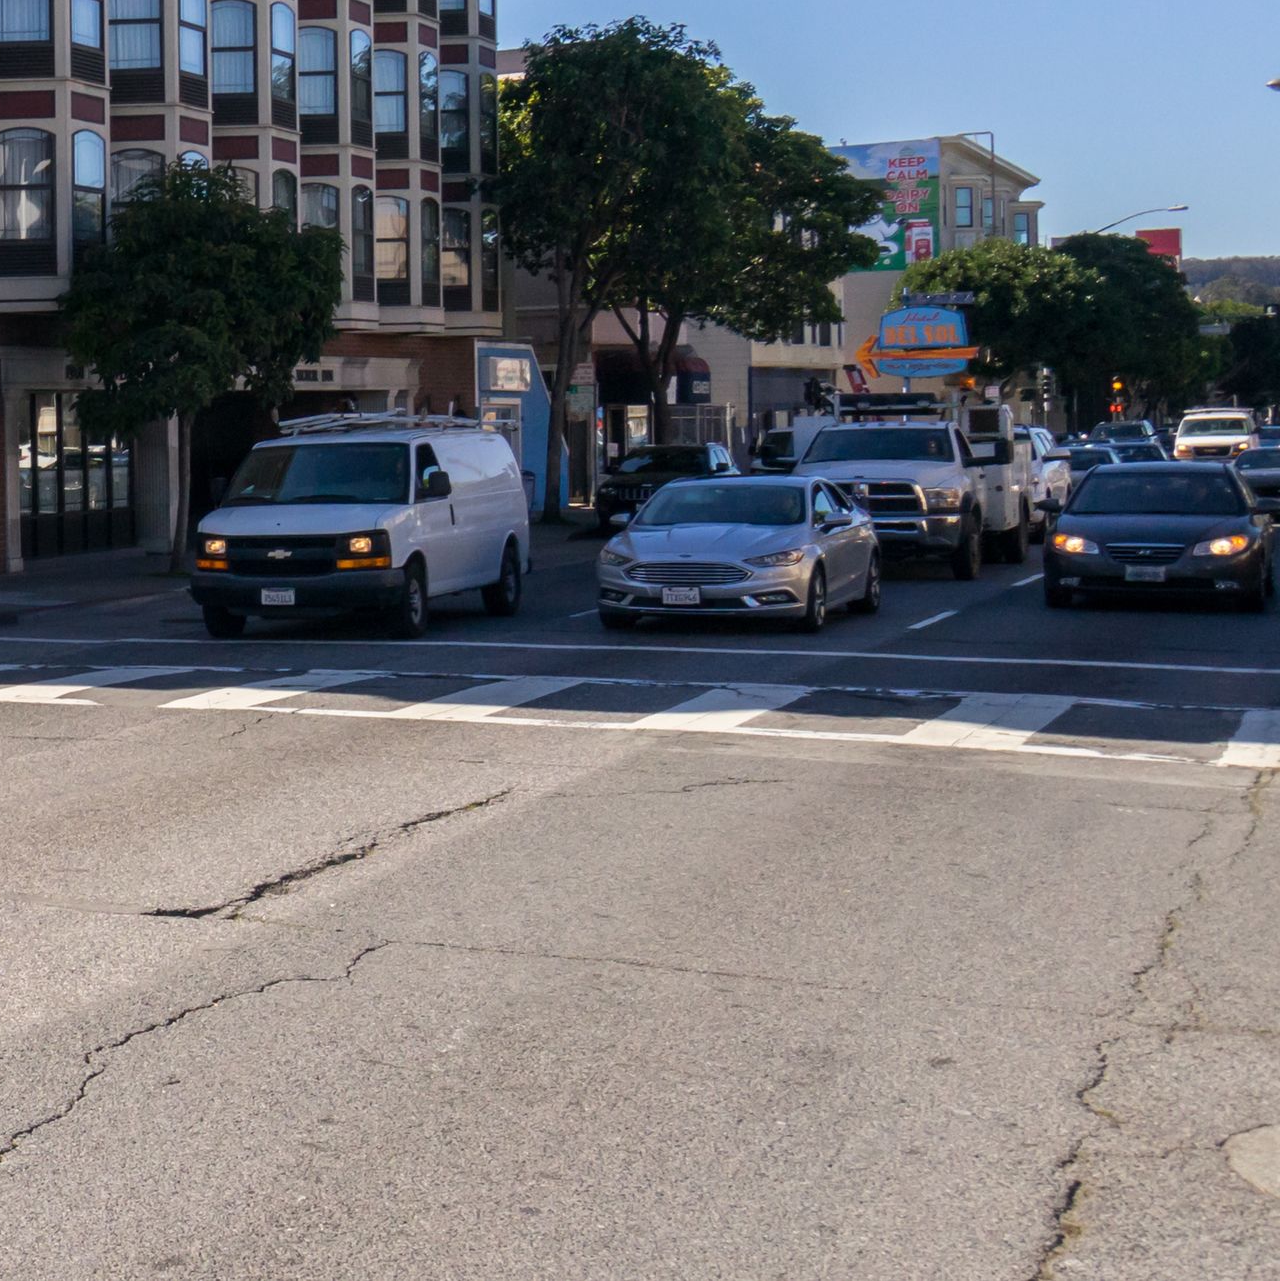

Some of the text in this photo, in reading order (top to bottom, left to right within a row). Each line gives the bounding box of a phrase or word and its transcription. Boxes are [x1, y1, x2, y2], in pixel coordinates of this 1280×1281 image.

[887, 156, 926, 169] KEEP
[886, 169, 928, 182] CALM
[883, 187, 931, 202] DAIRY
[896, 202, 920, 213] ON
[884, 324, 960, 345] DEL SOL
